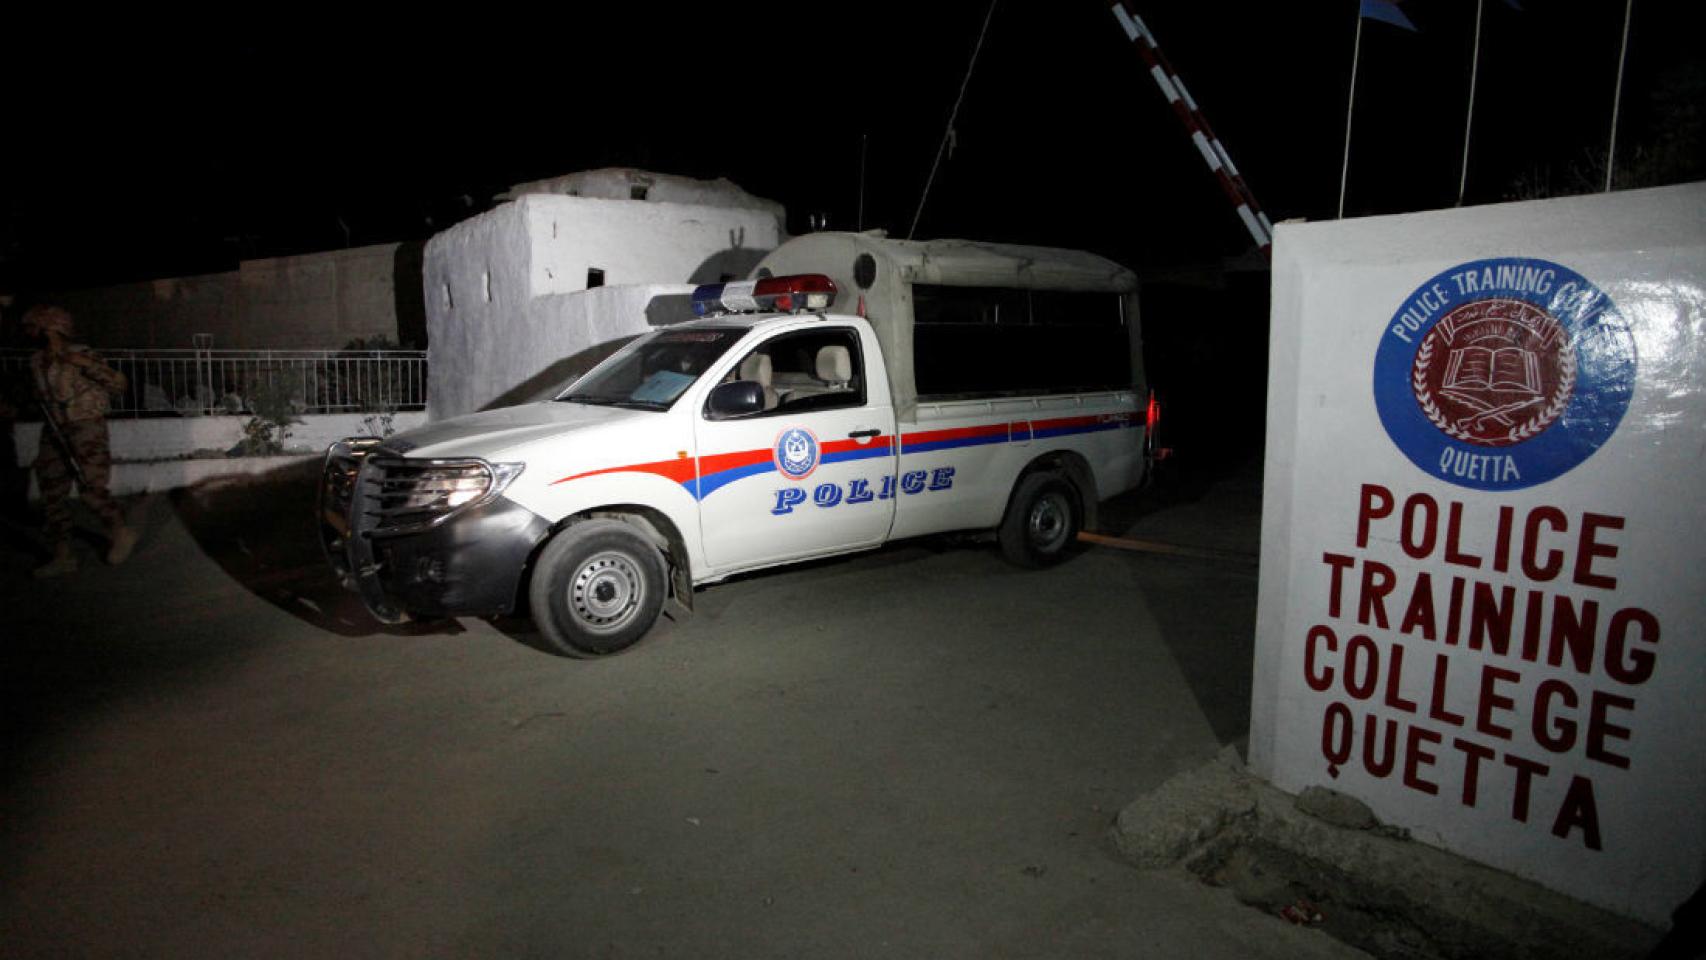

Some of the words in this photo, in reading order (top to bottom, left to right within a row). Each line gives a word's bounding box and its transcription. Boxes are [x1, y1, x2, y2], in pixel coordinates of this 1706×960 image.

[1391, 283, 1449, 343] POLICE
[1452, 265, 1555, 295] TRAINING
[771, 466, 956, 516] POLICE
[1439, 446, 1521, 483] QUETTA
[1356, 483, 1625, 590] POLICE
[1322, 552, 1661, 685] TRAINING
[1303, 624, 1636, 770] COLLEGE
[1320, 702, 1603, 851] QUETTA
